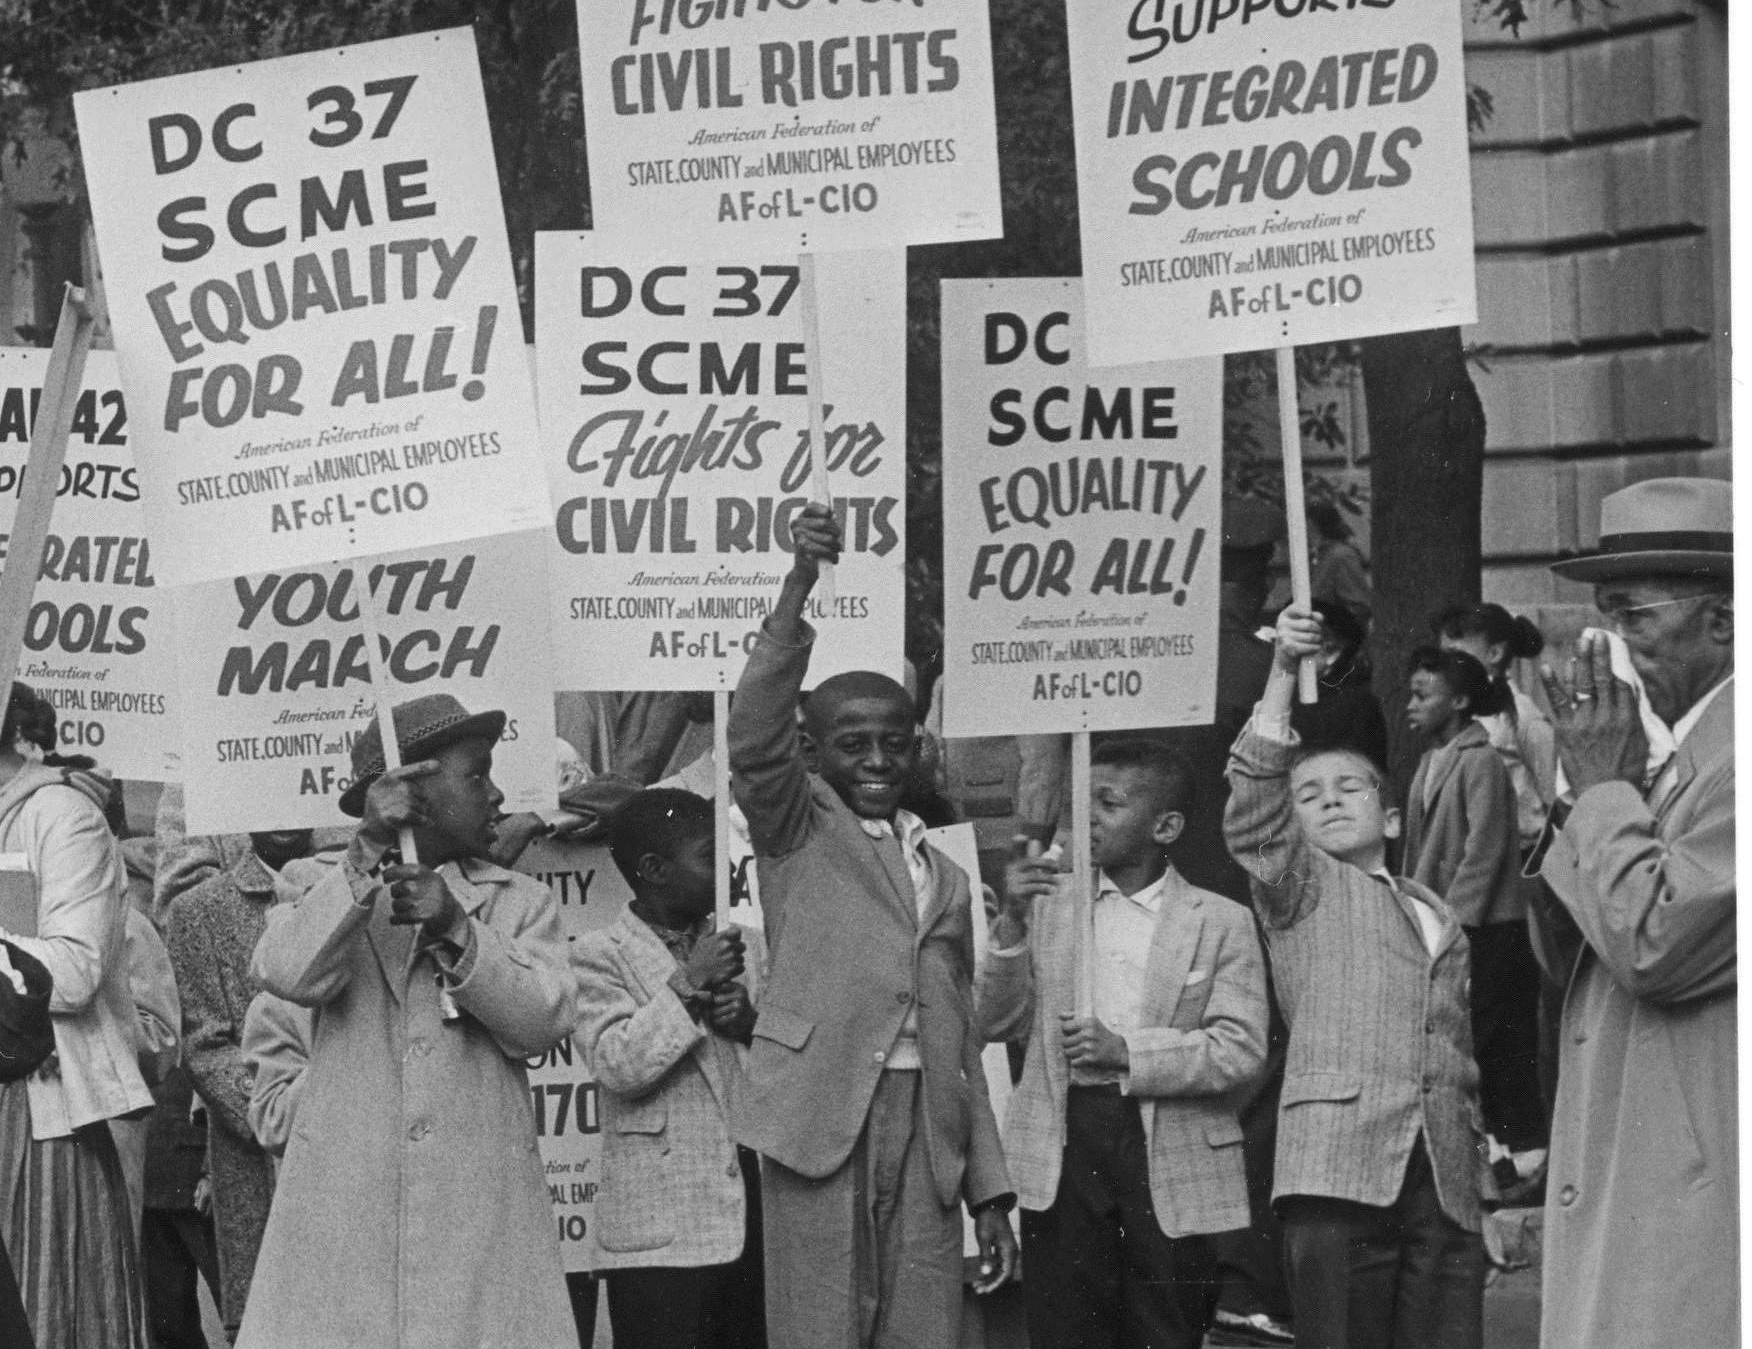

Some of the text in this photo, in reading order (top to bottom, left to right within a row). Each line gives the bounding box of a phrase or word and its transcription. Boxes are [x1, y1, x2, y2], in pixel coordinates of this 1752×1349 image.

[611, 29, 959, 115] CIVIL RIGHTS
[1107, 43, 1438, 138] INTEGRATED
[148, 74, 419, 175] DC 37
[688, 116, 881, 146] American Federation of
[767, 147, 853, 176] MUNICIPAL
[857, 139, 956, 168] EMPLOYEES
[1128, 126, 1422, 216] SCHOOLS
[157, 159, 437, 262] SCME
[1181, 209, 1365, 245] American Federation of
[1257, 241, 1339, 272] MUNICIPAL
[1343, 228, 1435, 261] EMPLOYEES
[145, 236, 477, 363] EQUALITY
[581, 265, 800, 318] DC 37
[985, 312, 1070, 365] DC
[164, 305, 498, 432] FOR ALL!
[580, 341, 808, 395] SCME
[235, 416, 424, 460] American Federation of
[988, 384, 1177, 447] SCME
[314, 447, 400, 484] MUNICIPAL
[403, 431, 501, 470] EMPLOYEES
[567, 404, 885, 499] Fights for
[979, 456, 1206, 533] EQUALITY
[556, 497, 697, 554] CIVIL
[234, 555, 476, 630] YOUTH
[628, 571, 781, 587] American Federation
[968, 528, 1206, 607] FOR ALL!
[24, 664, 91, 679] Federation
[217, 624, 501, 697] MARCH
[91, 693, 165, 714] EMPLOYEES
[273, 709, 345, 725] American
